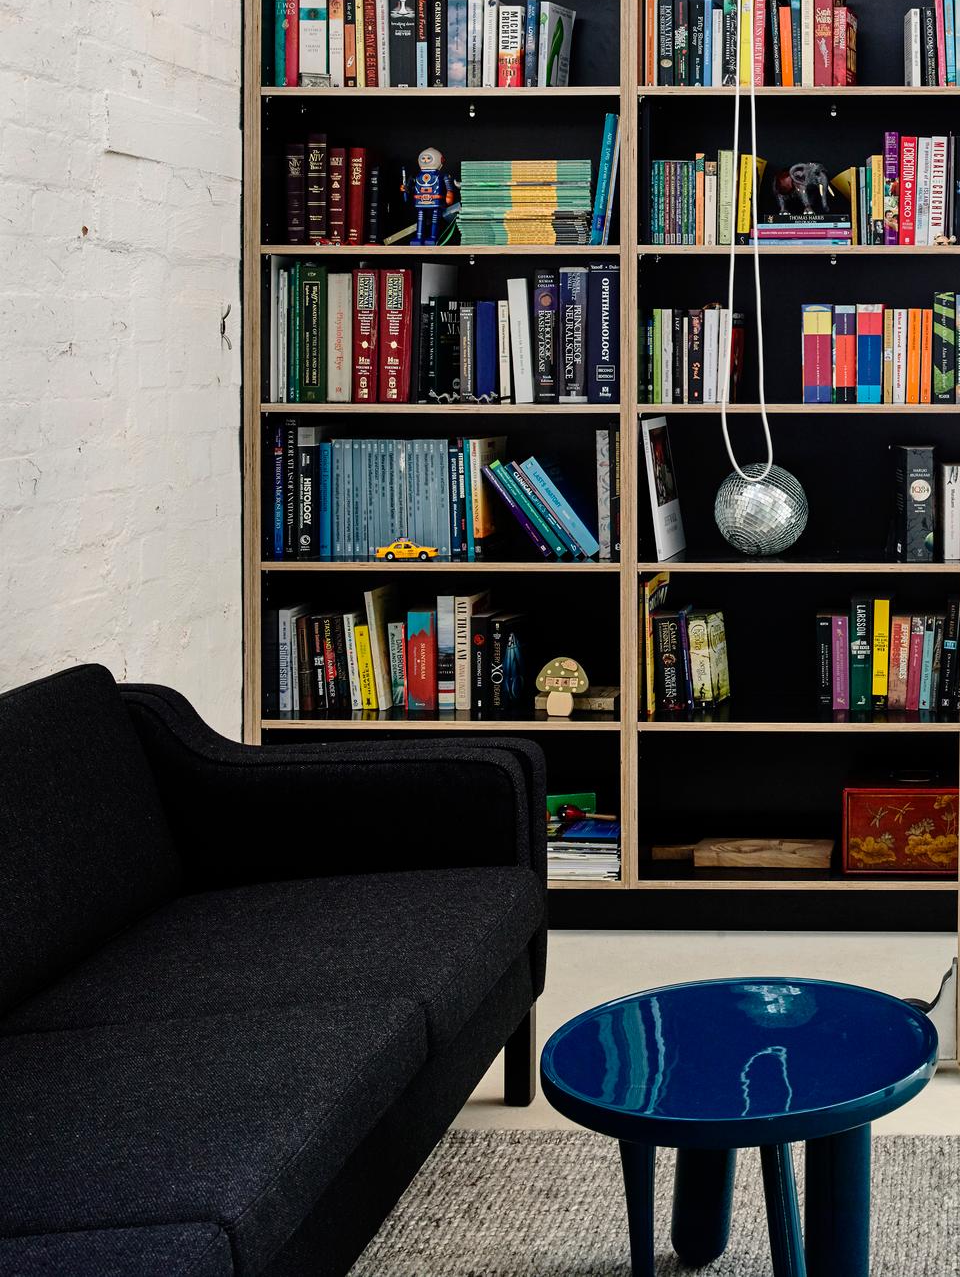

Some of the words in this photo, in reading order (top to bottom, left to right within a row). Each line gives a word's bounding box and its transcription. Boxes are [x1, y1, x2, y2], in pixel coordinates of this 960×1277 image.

[418, 19, 426, 40] French
[434, 1, 442, 33] GRISHAM
[502, 11, 510, 50] CRICHTON
[510, 11, 518, 50] MICHAEL
[755, 10, 764, 35] KRAUSS
[665, 29, 673, 57] TARTT
[755, 37, 763, 60] GREAT
[754, 63, 762, 85] HOUSE
[903, 148, 914, 181] CRICHTON
[933, 142, 944, 179] MICHAEL
[904, 190, 912, 217] MICRO
[931, 185, 942, 227] CRICHTON
[334, 312, 343, 352] Physiology
[565, 305, 573, 341] NEURAL
[573, 305, 581, 349] PRINCIPLES
[601, 278, 609, 361] OPHTHALMOLOGY
[334, 356, 343, 370] Eye
[538, 342, 546, 372] DISEASE
[565, 343, 574, 379] SCIENCE
[513, 471, 532, 496] CLINICAL
[303, 478, 311, 525] HISTOLOGY
[457, 601, 467, 615] ALL
[856, 605, 866, 636] LARSSON
[324, 619, 333, 650] STASILAND
[457, 617, 467, 638] THAT
[661, 621, 670, 652] THRONES
[669, 623, 677, 643] GAME
[901, 624, 909, 646] JEFFREY
[280, 645, 289, 691] Submission
[457, 646, 467, 660] AM
[899, 647, 907, 679] EUGENIDES
[328, 675, 336, 697] FUNDER
[491, 663, 503, 683] XO
[664, 667, 673, 698] MARTIN
